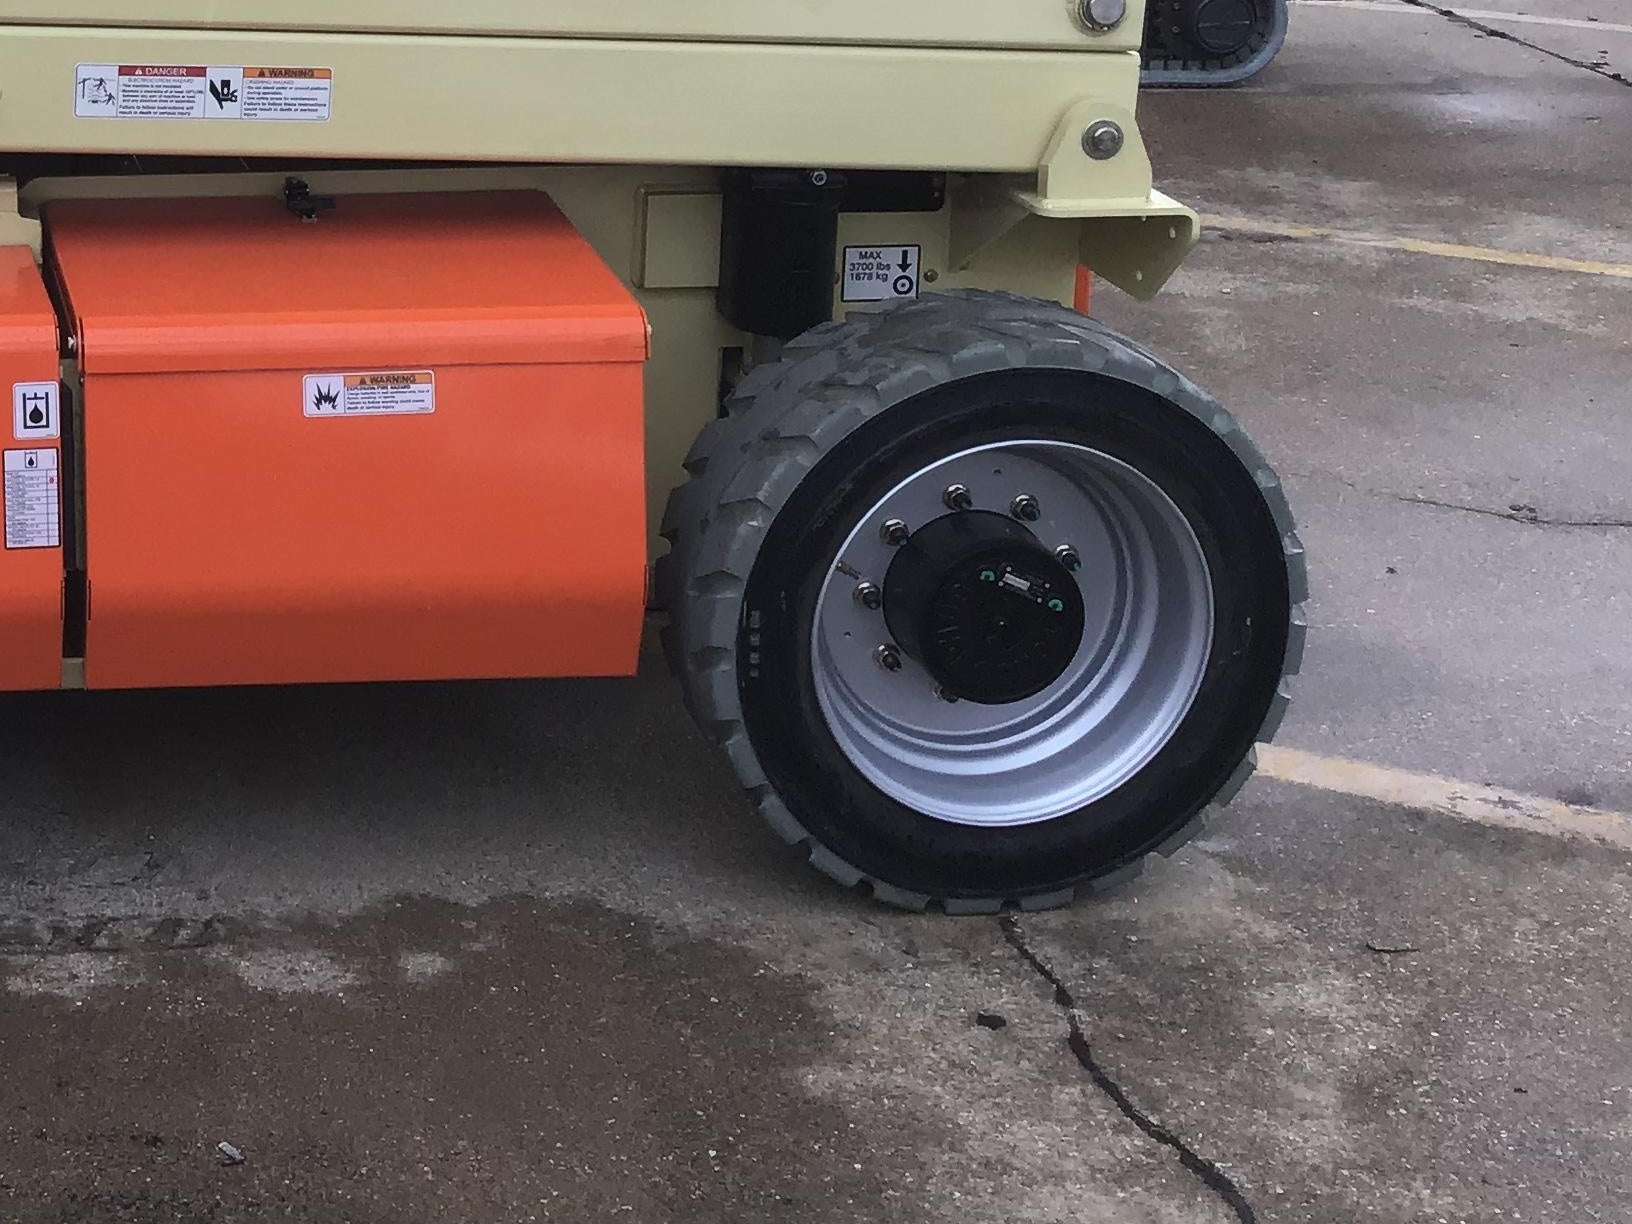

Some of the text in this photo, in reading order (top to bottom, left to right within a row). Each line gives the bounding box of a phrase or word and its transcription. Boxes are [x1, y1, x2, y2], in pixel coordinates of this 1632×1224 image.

[145, 67, 187, 76] DANGER
[269, 69, 314, 78] WARNING
[859, 250, 882, 260] MAX
[849, 262, 891, 271] 3700 lbs
[850, 272, 889, 282] 1678 kg
[370, 375, 416, 384] WARNING
